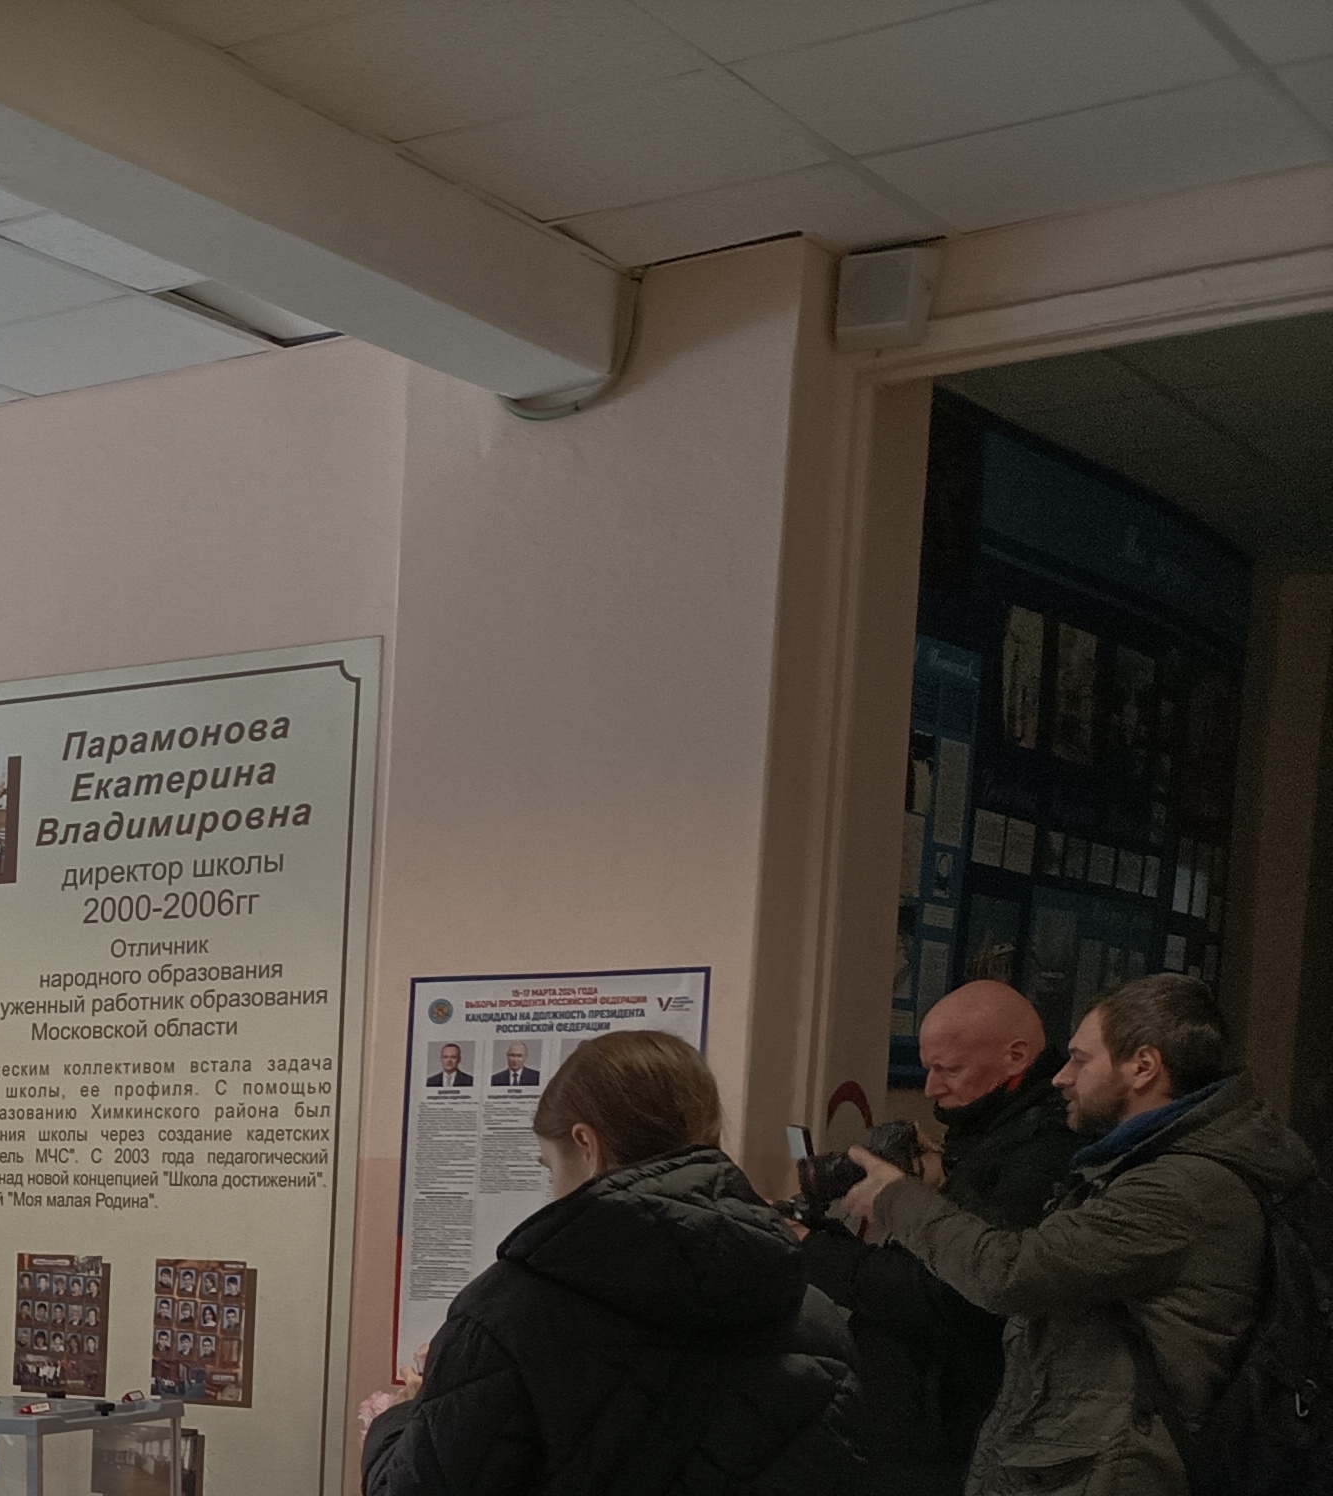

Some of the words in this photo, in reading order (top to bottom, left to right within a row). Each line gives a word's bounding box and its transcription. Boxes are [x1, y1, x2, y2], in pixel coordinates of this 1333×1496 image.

[62, 717, 290, 764] Парамонова
[71, 762, 276, 802] Екатерина
[36, 803, 311, 846] Владимировна
[61, 861, 183, 891] директор
[193, 854, 284, 878] школы
[83, 889, 260, 924] 2000-2006гг
[111, 939, 209, 958] Отличник
[40, 970, 141, 992] народного
[148, 964, 282, 987] образования
[92, 993, 184, 1017] работник
[190, 989, 328, 1012] образования
[465, 1012, 518, 1022] КАНДИДАТЫ
[519, 1012, 531, 1021] НА
[532, 1010, 587, 1022] ДОЛЖНОСТЬ
[588, 1008, 646, 1019] ПРЕЗИДЕНТА
[32, 1019, 147, 1041] Московской
[154, 1018, 237, 1037] области
[495, 1021, 554, 1034] РОССИЙСКОЙ
[556, 1021, 611, 1032] ФЕДЕРАЦИИ
[64, 1062, 175, 1075] коллективом
[190, 1060, 251, 1073] встала
[267, 1058, 332, 1073] задача
[6, 1086, 65, 1099] школы,
[114, 1081, 199, 1100] профиля.
[243, 1082, 331, 1097] помощью
[90, 1104, 200, 1119] Химкинского
[215, 1102, 278, 1122] района
[295, 1101, 330, 1118] был
[39, 1130, 87, 1142] школы
[101, 1130, 145, 1145] через
[158, 1129, 232, 1144] создание
[247, 1129, 329, 1144] кадетских
[36, 1148, 78, 1163] МЧС".
[114, 1148, 149, 1164] 2003
[162, 1152, 194, 1166] года
[207, 1149, 328, 1166] педагогический
[28, 1170, 69, 1185] новой
[73, 1171, 158, 1188] концепцией
[163, 1171, 218, 1187] "Школа
[221, 1172, 326, 1189] достижений".
[8, 1191, 42, 1207] "Моя
[47, 1196, 91, 1207] малая
[95, 1192, 158, 1210] Родина".
